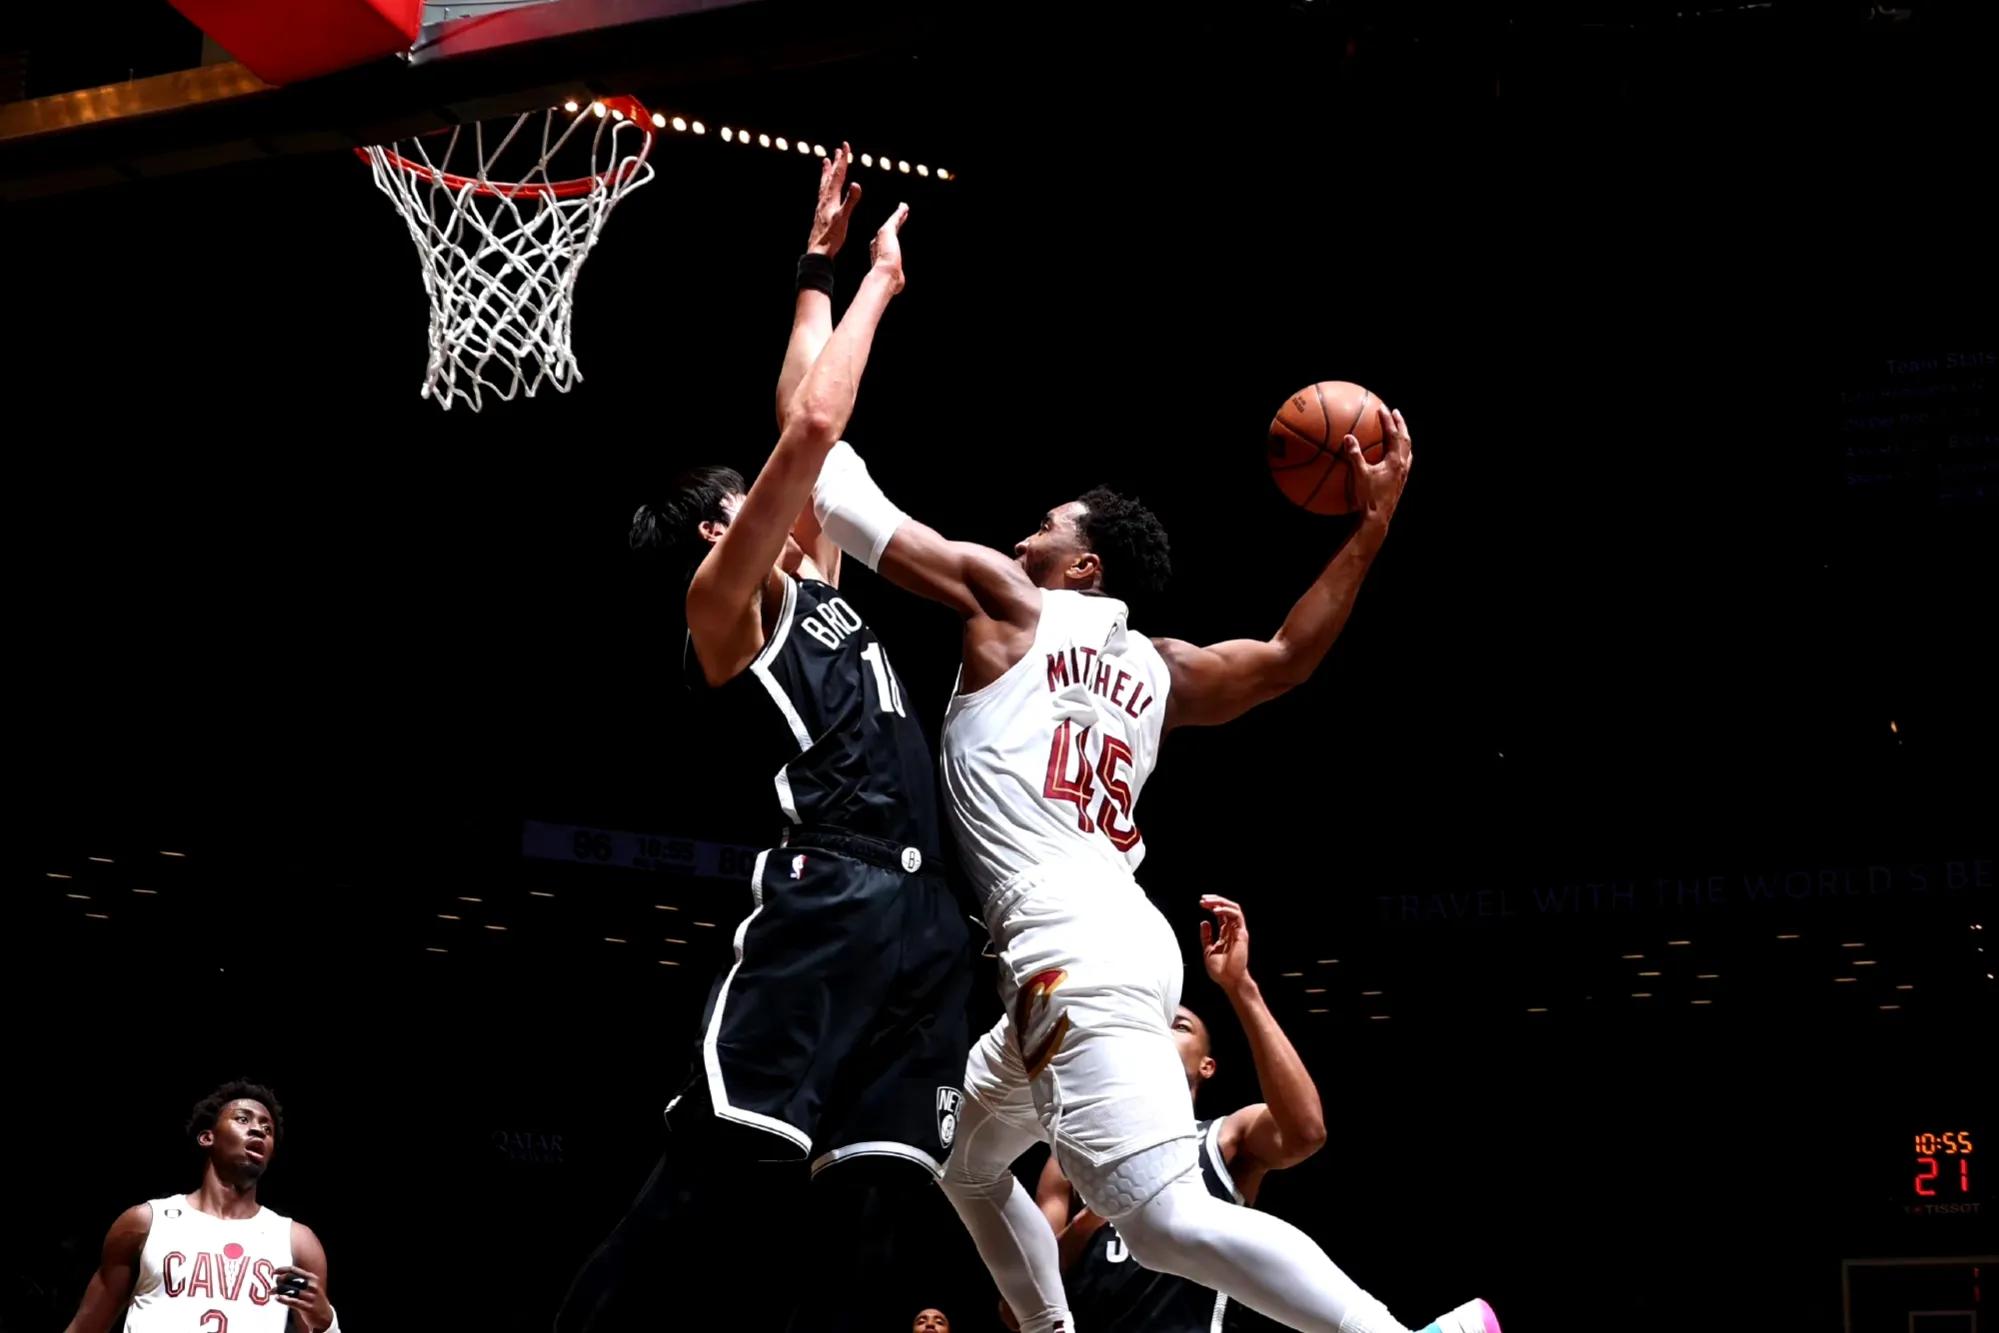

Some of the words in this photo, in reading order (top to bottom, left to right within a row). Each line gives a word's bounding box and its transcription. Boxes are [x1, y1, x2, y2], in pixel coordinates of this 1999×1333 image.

[801, 597, 863, 650] BRO
[1046, 646, 1153, 719] MITHEL
[1043, 717, 1141, 852] 45
[1376, 888, 1519, 920] TRAVEL
[1532, 879, 1640, 912] WITH
[1654, 876, 1728, 907] THE
[1743, 864, 1930, 902] WORLDS
[490, 1130, 564, 1152] QATAR
[1915, 1131, 1973, 1155] 10:55
[1915, 1157, 1968, 1196] 21
[1924, 1203, 1981, 1215] TISSOT
[163, 1251, 276, 1306] CAVS
